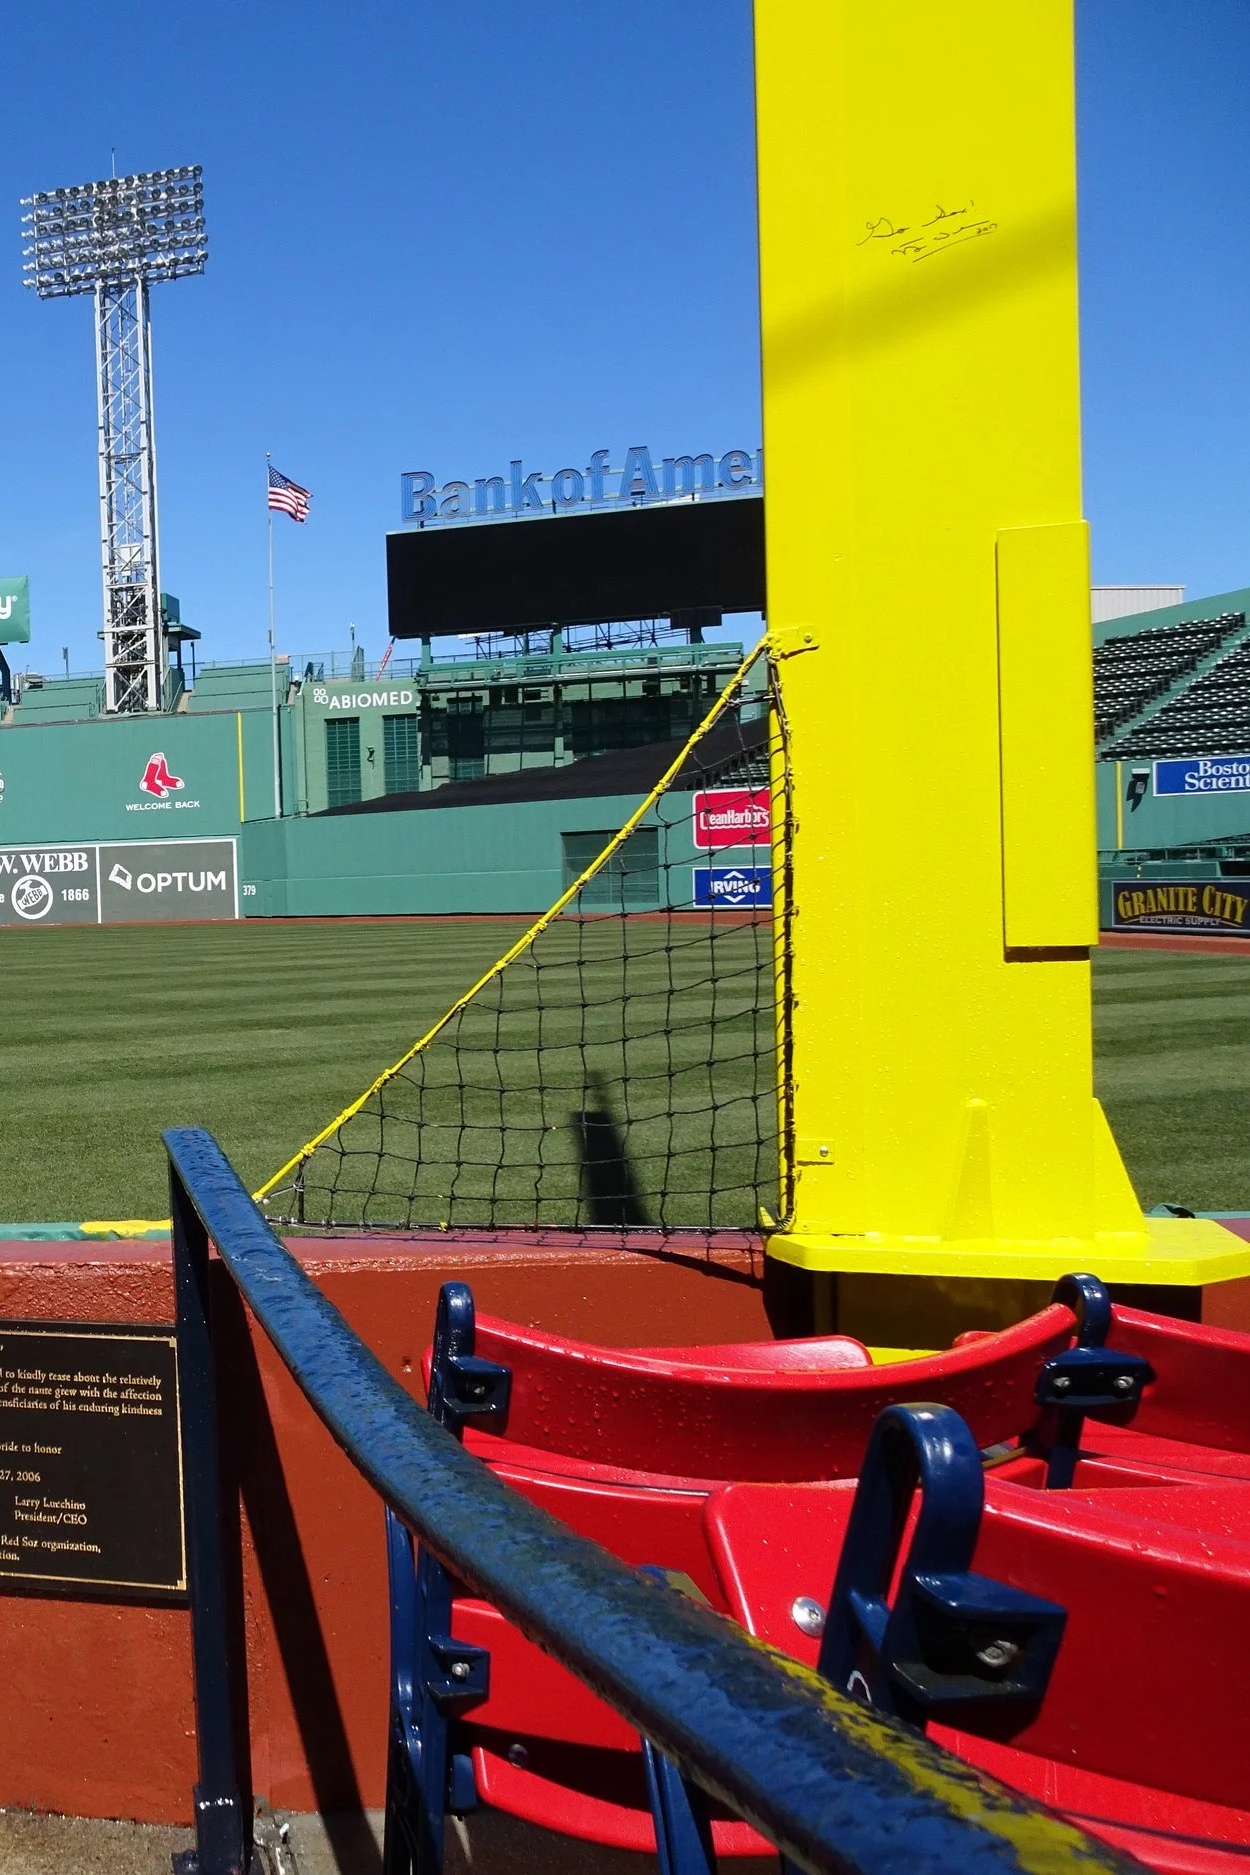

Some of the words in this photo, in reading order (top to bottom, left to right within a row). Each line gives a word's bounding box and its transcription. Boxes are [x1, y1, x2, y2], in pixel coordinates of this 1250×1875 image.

[400, 459, 543, 524] Bank
[551, 449, 610, 506] of
[329, 690, 412, 710] ABIOMED
[1198, 760, 1250, 777] Bosto
[125, 802, 172, 811] WELCOME
[175, 800, 200, 809] BACK
[19, 851, 89, 874] WEBB
[136, 870, 226, 893] OPTUM
[710, 880, 761, 894] IRVING
[21, 888, 43, 907] WEBB
[61, 888, 89, 901] 1866
[242, 885, 256, 896] 379
[1117, 886, 1198, 919] GRANITE
[1203, 885, 1248, 923] CITY
[1139, 915, 1184, 924] ELECTRIC
[1185, 916, 1221, 926] SUPPLY
[5, 1369, 15, 1379] to
[17, 1370, 46, 1384] kindly
[49, 1371, 71, 1381] tease
[73, 1372, 100, 1382] about
[102, 1373, 117, 1383] the
[119, 1374, 162, 1389] relatively
[11, 1383, 26, 1393] the
[54, 1388, 77, 1399] grew
[79, 1387, 100, 1397] with
[102, 1387, 118, 1397] the
[120, 1388, 162, 1400] affection
[21, 1442, 31, 1452] to
[34, 1443, 62, 1453] honor
[0, 1470, 14, 1482] 27,
[16, 1471, 41, 1482] 2006
[15, 1496, 40, 1511] Larry
[43, 1498, 86, 1510] Lucchino
[14, 1511, 88, 1525] President/CEO
[1, 1534, 19, 1545] Red
[22, 1536, 38, 1546] Sox
[41, 1539, 101, 1553] organization,
